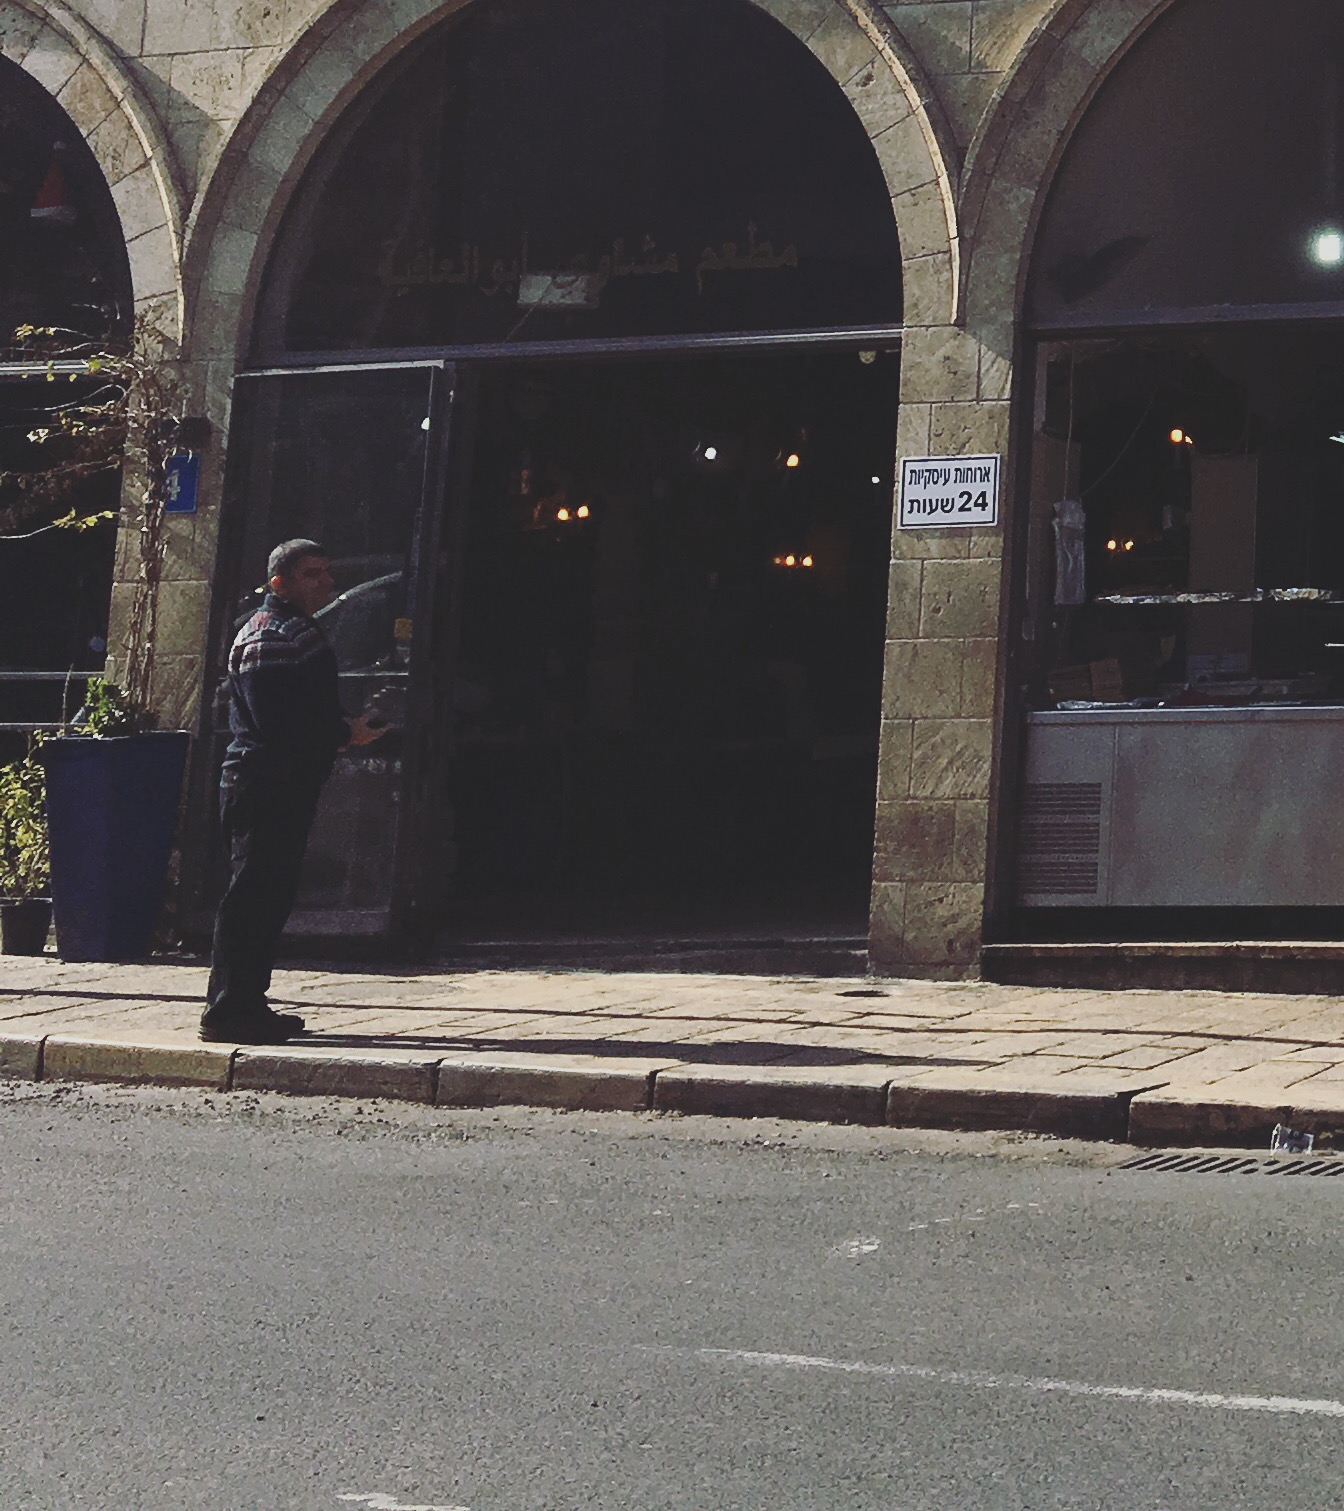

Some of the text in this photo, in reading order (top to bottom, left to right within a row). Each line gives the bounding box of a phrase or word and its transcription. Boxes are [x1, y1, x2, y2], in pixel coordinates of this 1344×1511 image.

[908, 466, 991, 490] ארוחות עיסקיות
[907, 490, 988, 515] 24 שעות
